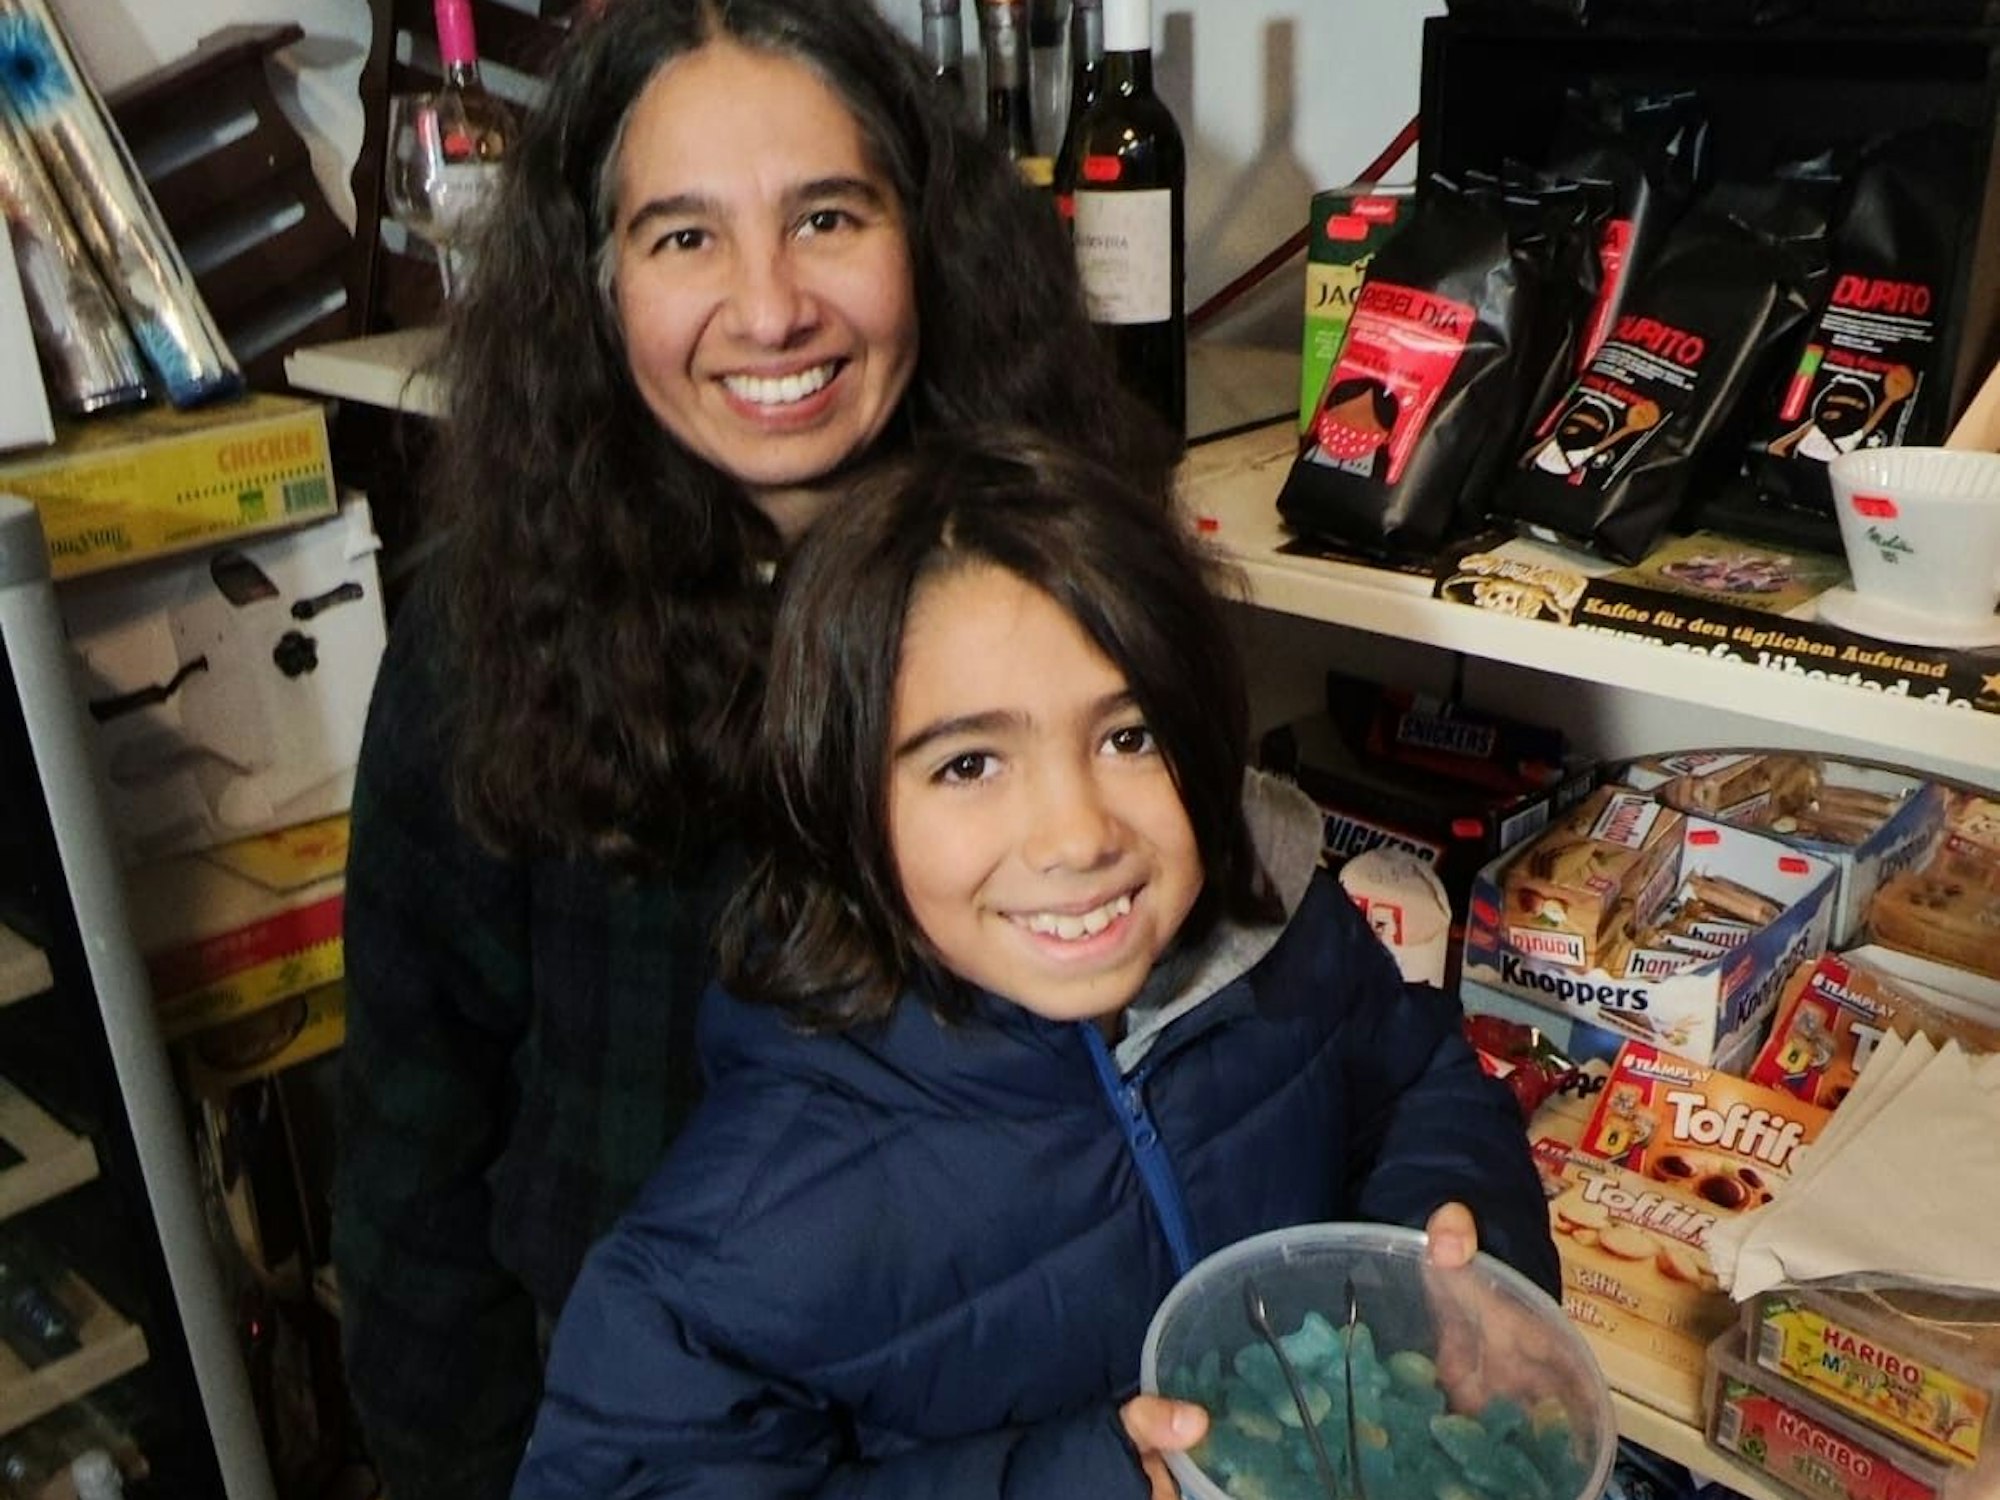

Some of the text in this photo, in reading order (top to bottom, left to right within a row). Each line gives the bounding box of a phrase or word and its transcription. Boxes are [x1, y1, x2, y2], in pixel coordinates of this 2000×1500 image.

[1832, 274, 1932, 317] DURITO
[217, 428, 312, 473] CHICKEN
[1583, 597, 1948, 679] Kaffee für den täglichen Aufstand
[1405, 715, 1491, 754] SNICKERS
[1501, 954, 1649, 1011] Knoppers
[1578, 1170, 1717, 1237] Toffif
[1822, 1326, 1920, 1385] HARIBO
[1778, 1413, 1870, 1478] HARIBO
